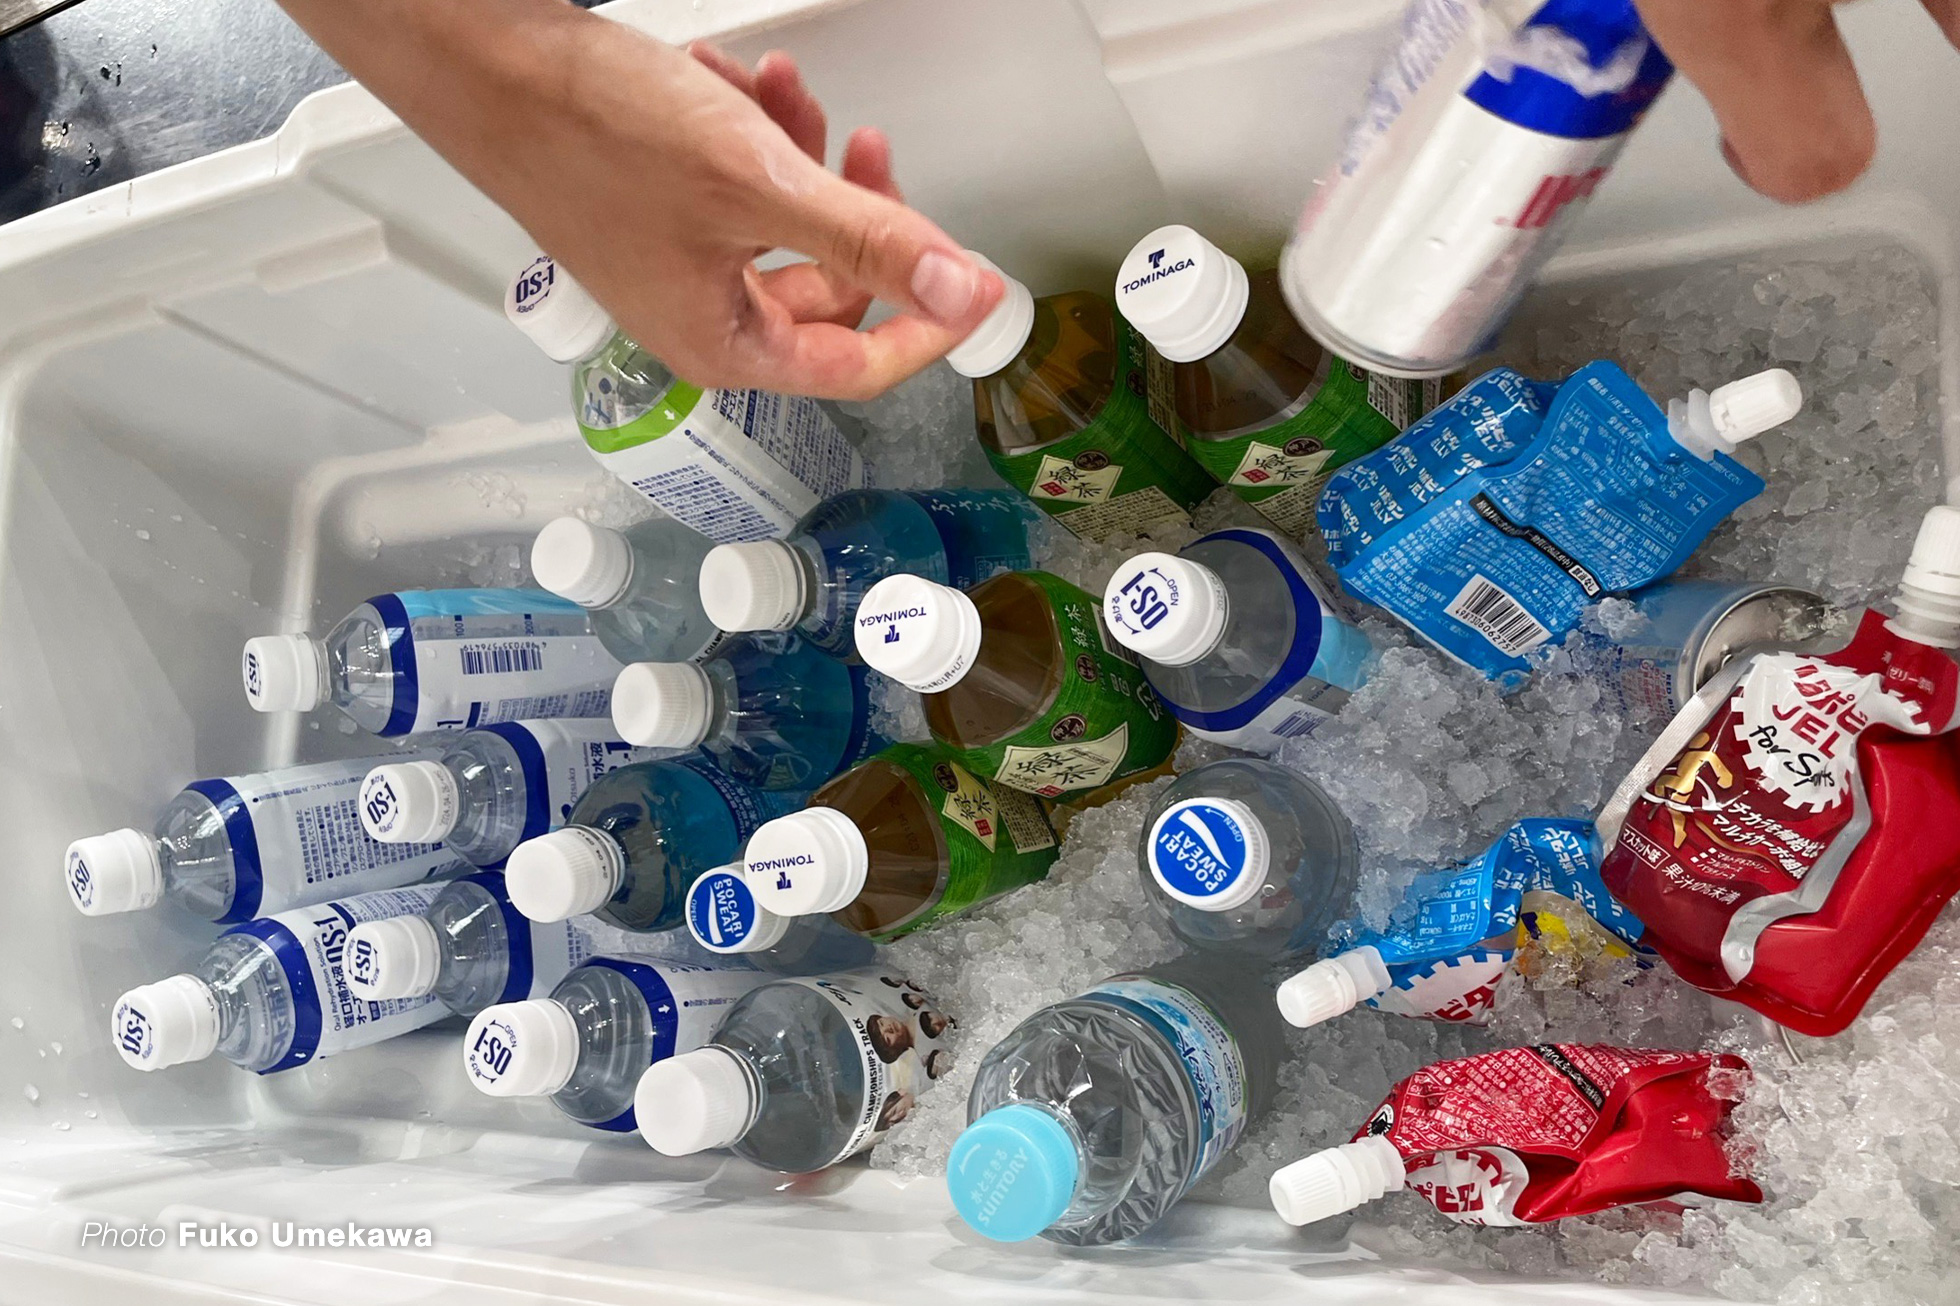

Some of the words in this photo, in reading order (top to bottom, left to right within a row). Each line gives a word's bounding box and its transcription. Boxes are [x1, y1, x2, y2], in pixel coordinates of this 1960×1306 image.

[516, 262, 554, 304] OS-1
[1122, 258, 1196, 295] TOMINAGA
[1370, 497, 1394, 525] JELLY
[1120, 571, 1169, 630] OS-1
[1166, 578, 1179, 606] OPEN
[859, 606, 927, 627] TOMINAGA
[1749, 725, 1791, 754] for
[1017, 751, 1100, 786] 緑茶
[367, 781, 397, 825] OS-1
[1223, 816, 1243, 842] OPEN
[1622, 829, 1663, 864] マスカット味
[748, 854, 815, 873] TOMINAGA
[1159, 833, 1220, 892] POCARI
[1172, 830, 1228, 882] SWEAT
[71, 859, 91, 901] OS-1
[1661, 862, 1742, 906] 果汁10%未満
[713, 880, 735, 934] SWEAT
[722, 878, 745, 938] POCARI
[355, 939, 373, 986] OS-1
[122, 1007, 146, 1056] OS-1
[474, 1027, 513, 1076] OS-1
[504, 1024, 517, 1048] OPEN
[853, 1018, 872, 1048] TRACK
[863, 1049, 878, 1125] CHAMPIONSHIPS
[969, 1150, 1008, 1204] 水と生きる
[976, 1147, 1029, 1228] SUNTORY
